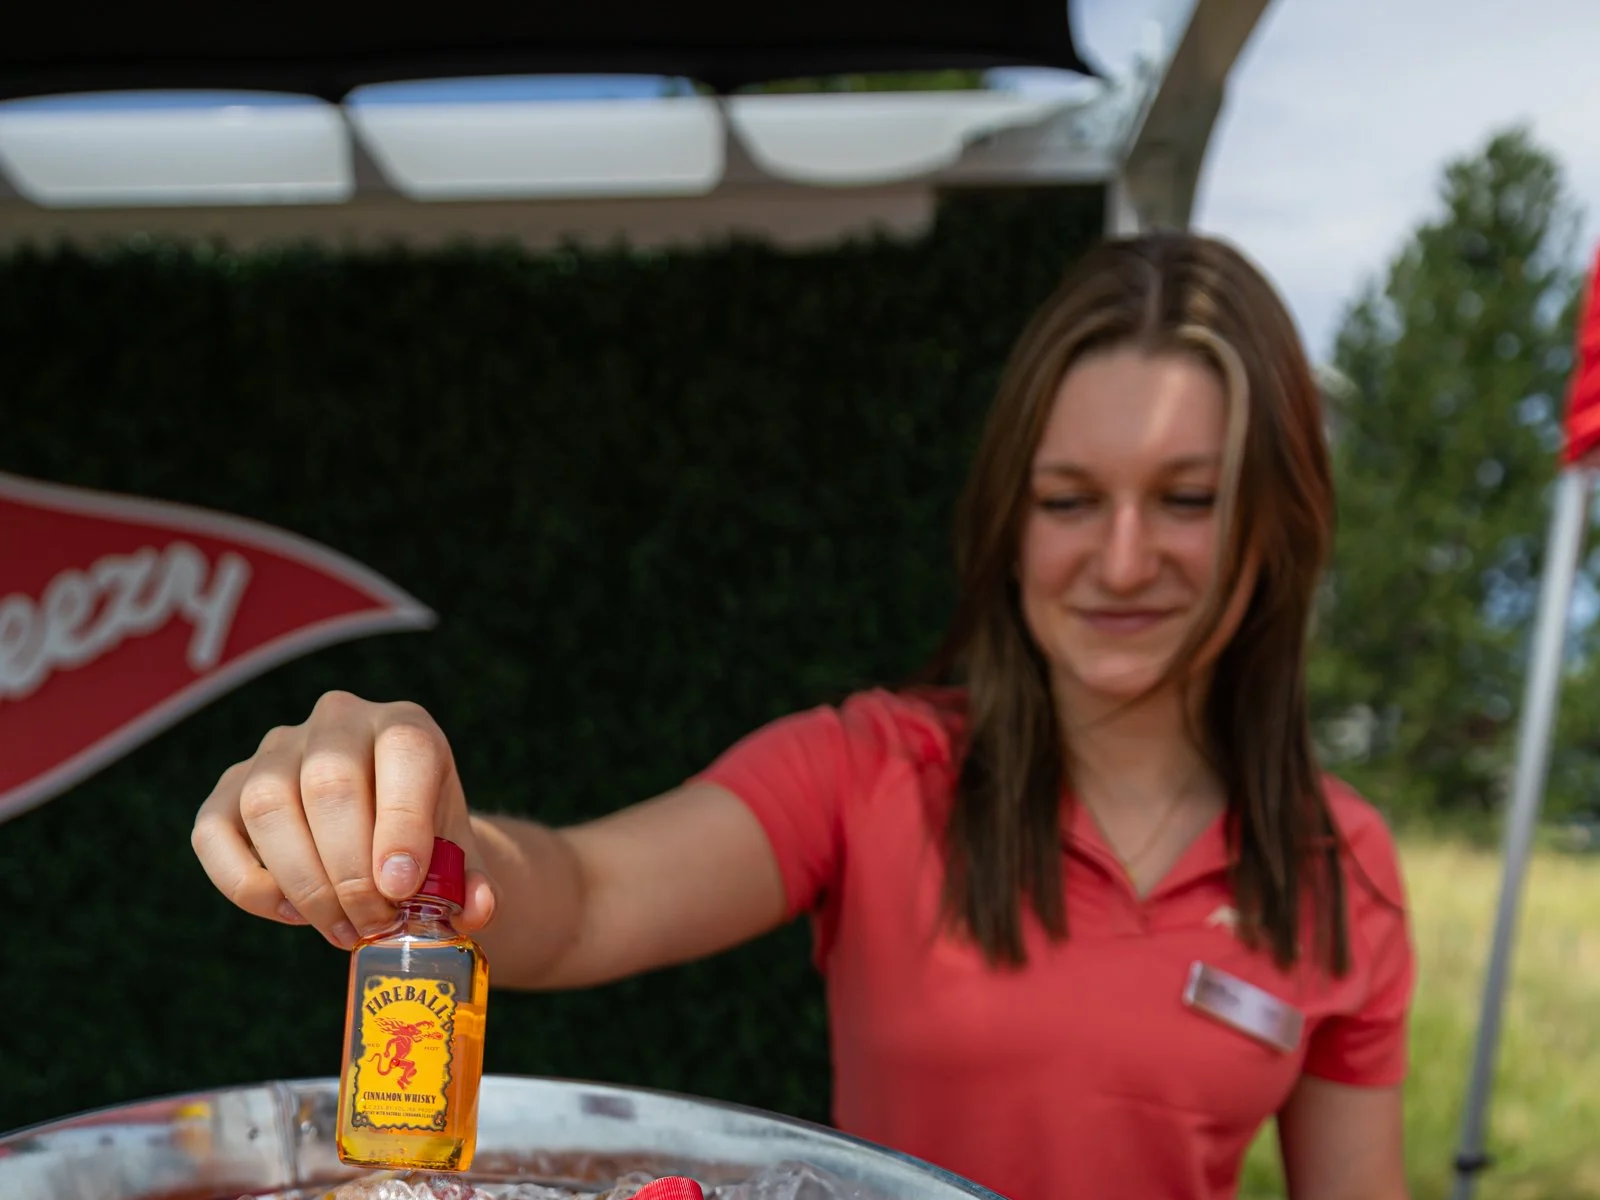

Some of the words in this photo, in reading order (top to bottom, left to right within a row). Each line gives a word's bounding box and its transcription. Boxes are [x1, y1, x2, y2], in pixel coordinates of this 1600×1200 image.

[365, 985, 450, 1019] FIREBALL
[363, 1091, 402, 1102] CINNAMON
[404, 1093, 437, 1105] WHISKY
